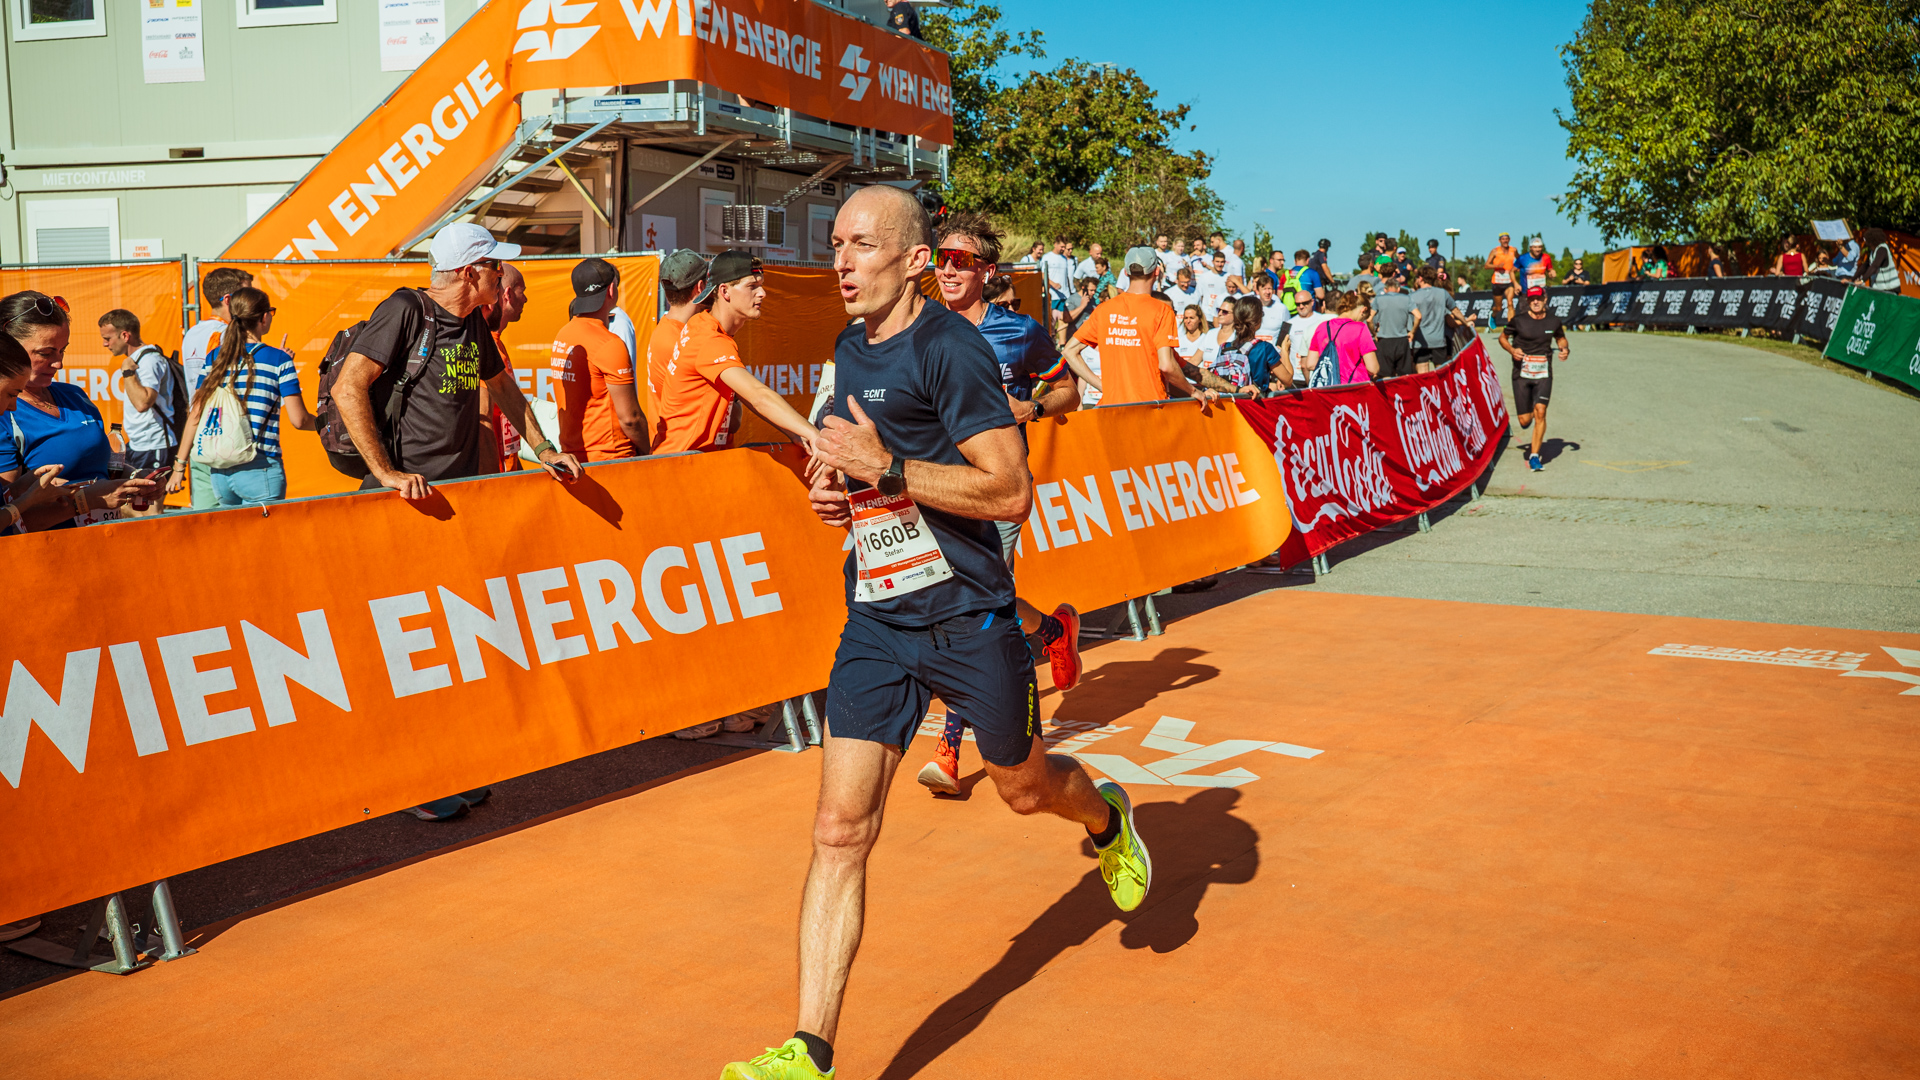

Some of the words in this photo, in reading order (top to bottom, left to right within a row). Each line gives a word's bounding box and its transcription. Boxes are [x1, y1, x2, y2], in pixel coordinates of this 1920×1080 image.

[620, 0, 729, 49] WIEN
[732, 11, 821, 80] ENERGIE
[878, 62, 918, 107] WIEN
[328, 59, 504, 237] ENERGIE
[42, 170, 146, 186] MIETCONTAINER
[1549, 295, 1574, 307] POWER
[1635, 290, 1660, 303] POWER
[1663, 290, 1686, 303] POWER
[1690, 290, 1715, 303] POWER
[1719, 289, 1744, 303] POWER
[1748, 289, 1773, 303] POWER
[1823, 295, 1843, 314] POWE
[1846, 336, 1872, 356] QUELLE
[551, 357, 572, 369] LAUFEND
[745, 364, 803, 395] WIEN
[1274, 402, 1393, 534] Coca-Cola
[1394, 385, 1465, 492] Coca-Cola
[866, 495, 905, 510] ENERGIE
[1014, 475, 1113, 558] IEN
[1110, 452, 1261, 531] ENERGIE
[863, 521, 920, 553] 1660B
[884, 547, 904, 558] Stefan
[915, 553, 932, 561] Consulting
[0, 609, 352, 789] WIEN
[368, 531, 783, 699] ENERGIE
[1026, 682, 1035, 737] CRAZY
